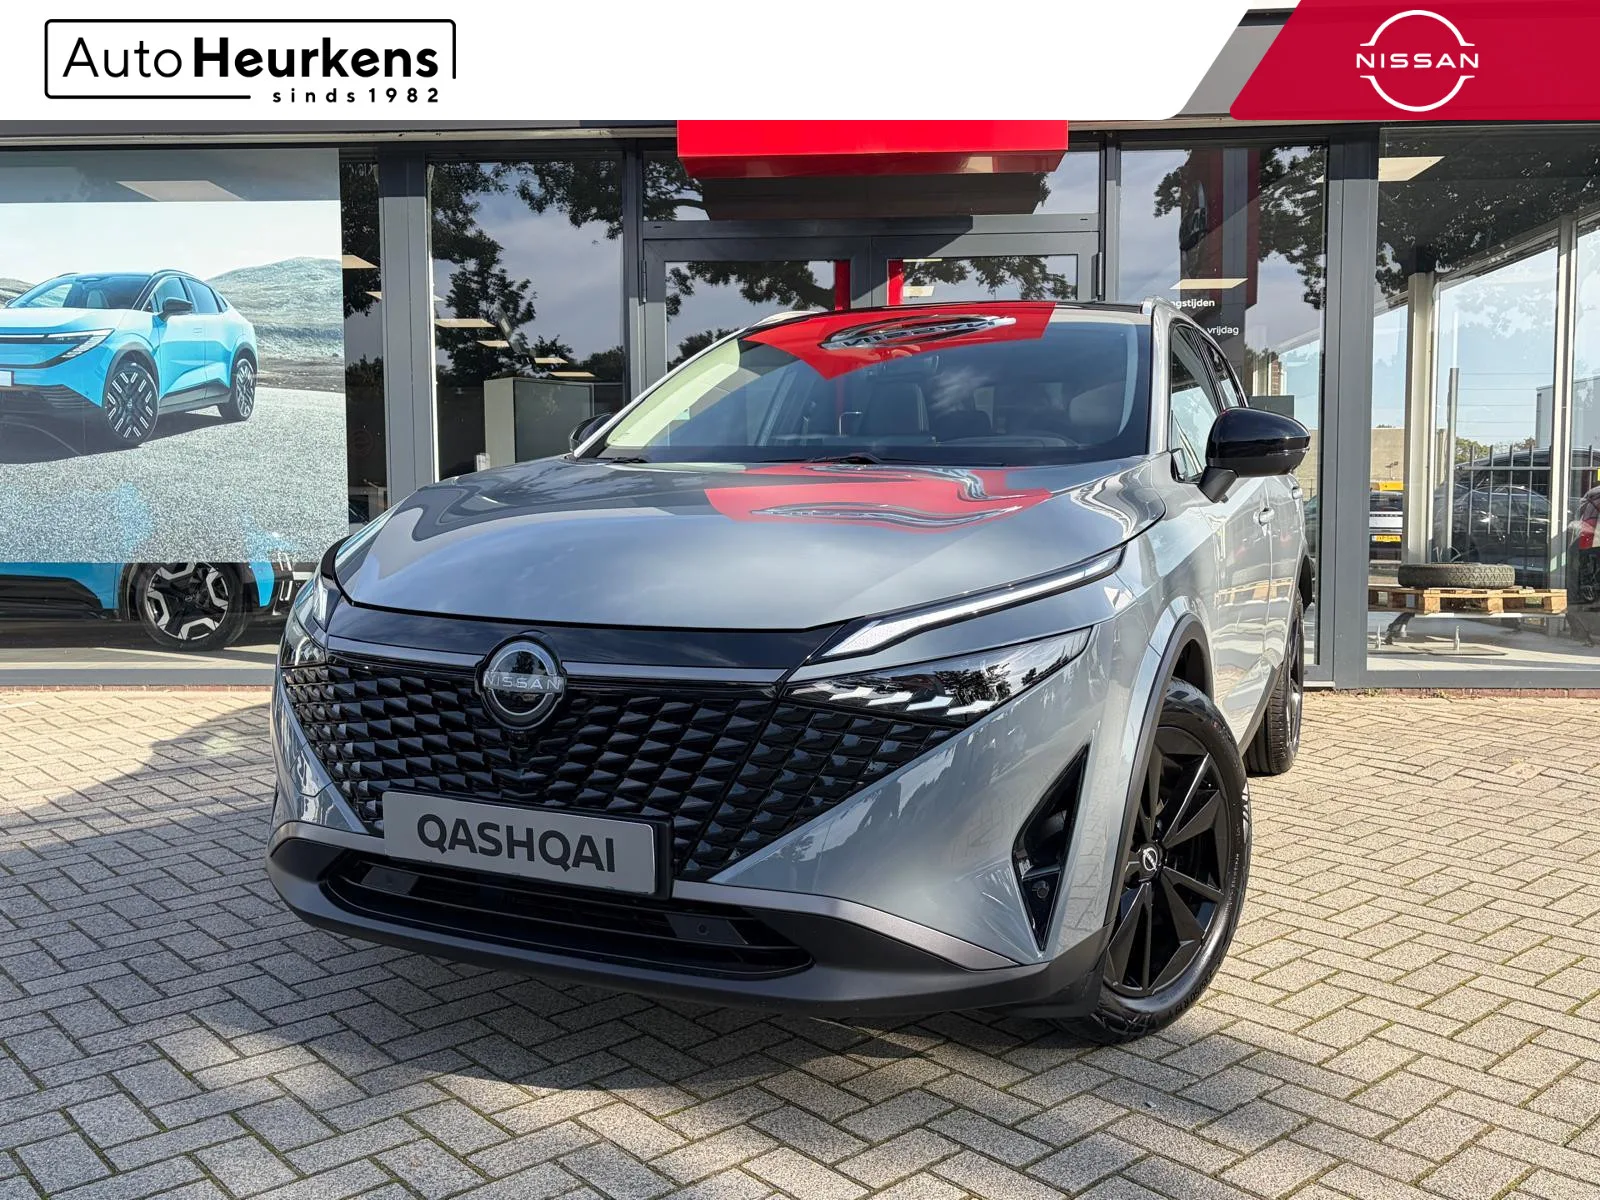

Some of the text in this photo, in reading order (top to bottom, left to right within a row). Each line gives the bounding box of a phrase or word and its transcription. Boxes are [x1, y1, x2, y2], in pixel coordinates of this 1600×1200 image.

[1206, 325, 1239, 335] vrijdag
[483, 672, 561, 690] NISSAN
[416, 812, 616, 873] QASHQAI
